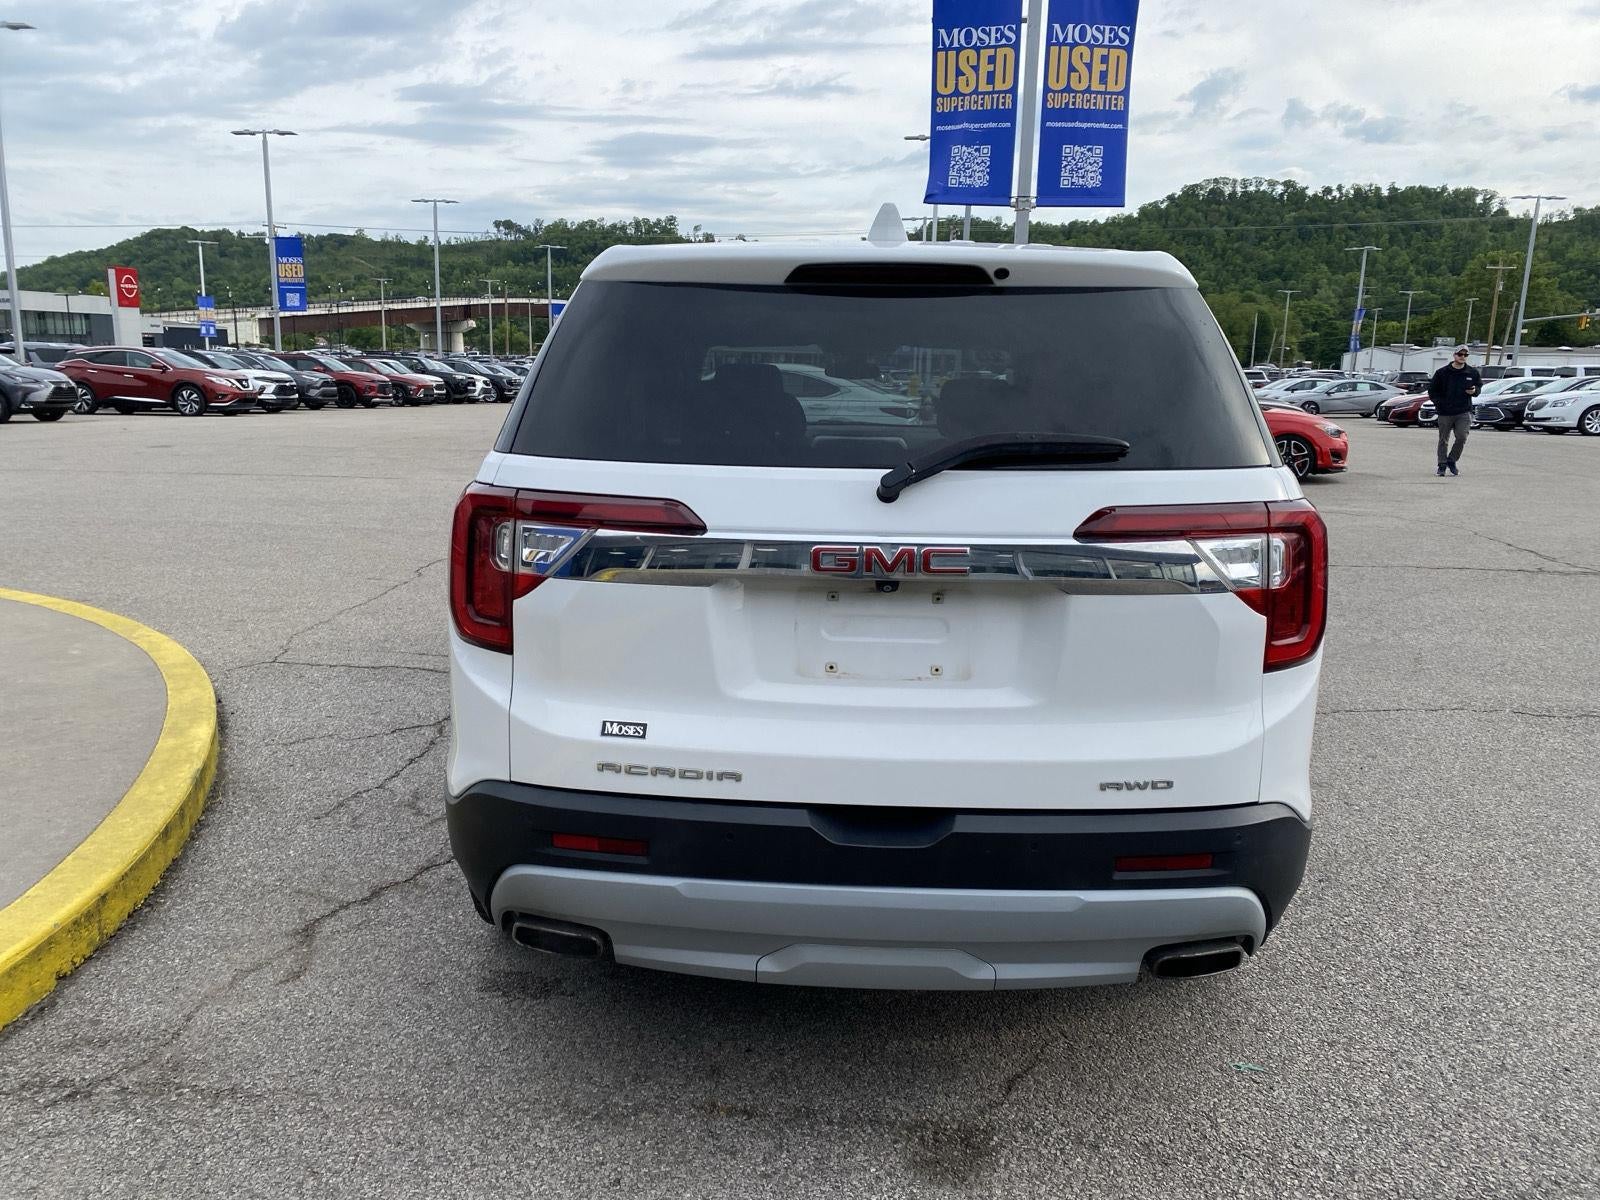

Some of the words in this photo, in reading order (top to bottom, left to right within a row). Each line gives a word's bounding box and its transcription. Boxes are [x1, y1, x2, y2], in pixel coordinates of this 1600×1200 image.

[937, 24, 1016, 49] MOSES
[1052, 23, 1131, 46] MOSES
[936, 47, 1015, 95] USED
[1047, 45, 1128, 92] USED
[936, 94, 1013, 113] SUPERCENTER
[1046, 92, 1125, 111] SUPERCENTER
[936, 122, 1011, 131] mosesusedsupercenter.com
[1046, 121, 1123, 130] mosesusedsupercenter.com
[278, 263, 304, 278] USED
[810, 545, 970, 576] GMC
[596, 762, 743, 783] ACADIA
[1099, 780, 1174, 791] AWD
